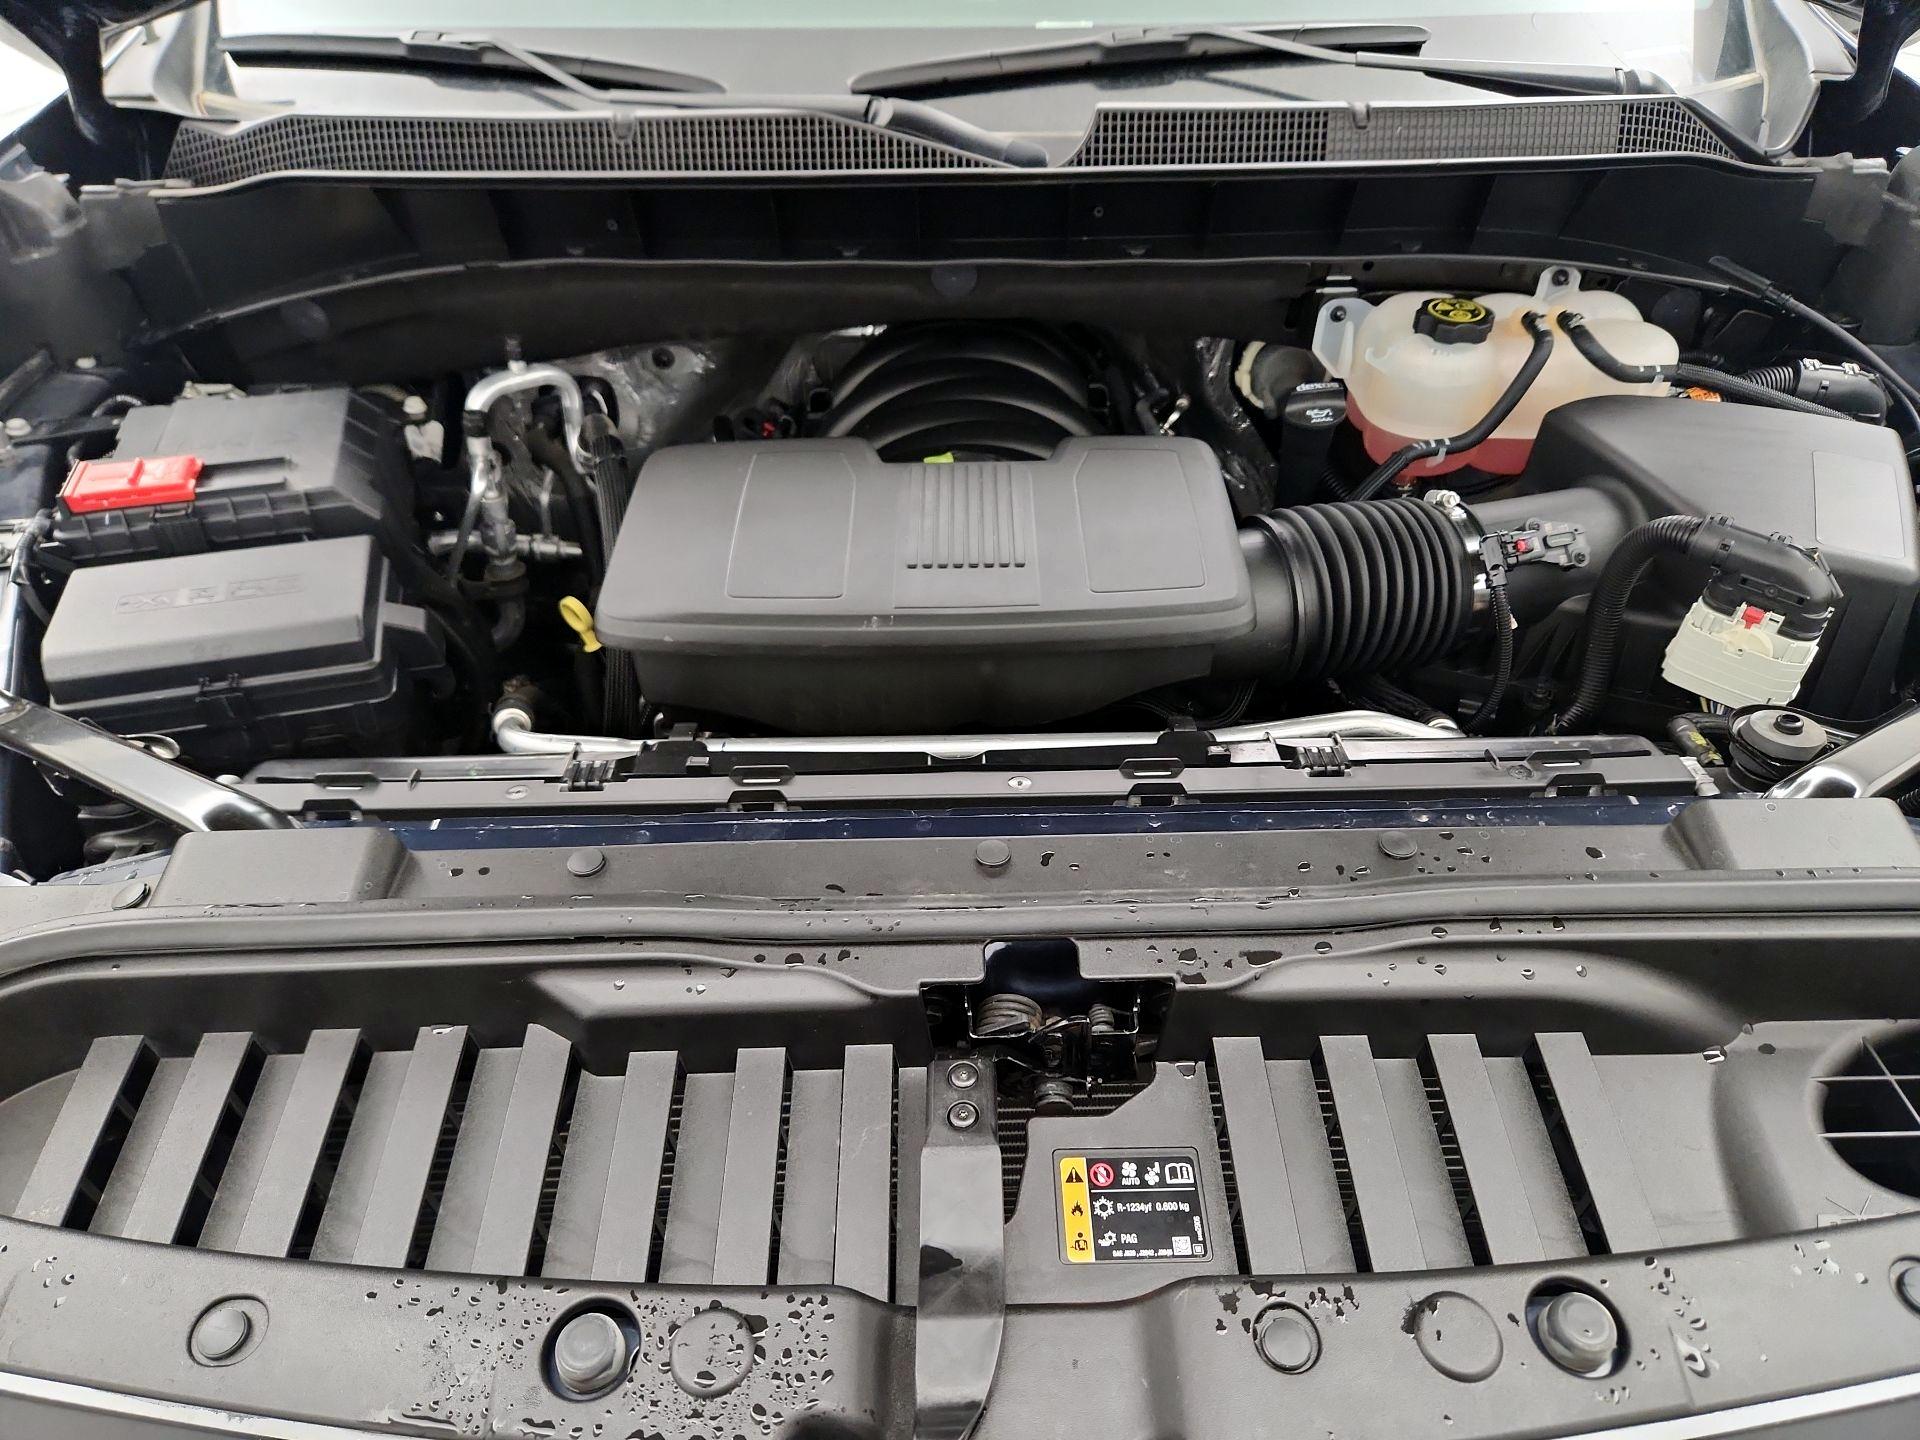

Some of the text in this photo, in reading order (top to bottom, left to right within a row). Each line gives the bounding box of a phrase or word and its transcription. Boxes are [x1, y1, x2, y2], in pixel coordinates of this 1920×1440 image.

[1121, 1177, 1140, 1186] AUTO
[1116, 1201, 1190, 1213] R-1234yf 0.600 kg
[1121, 1233, 1138, 1244] PAG
